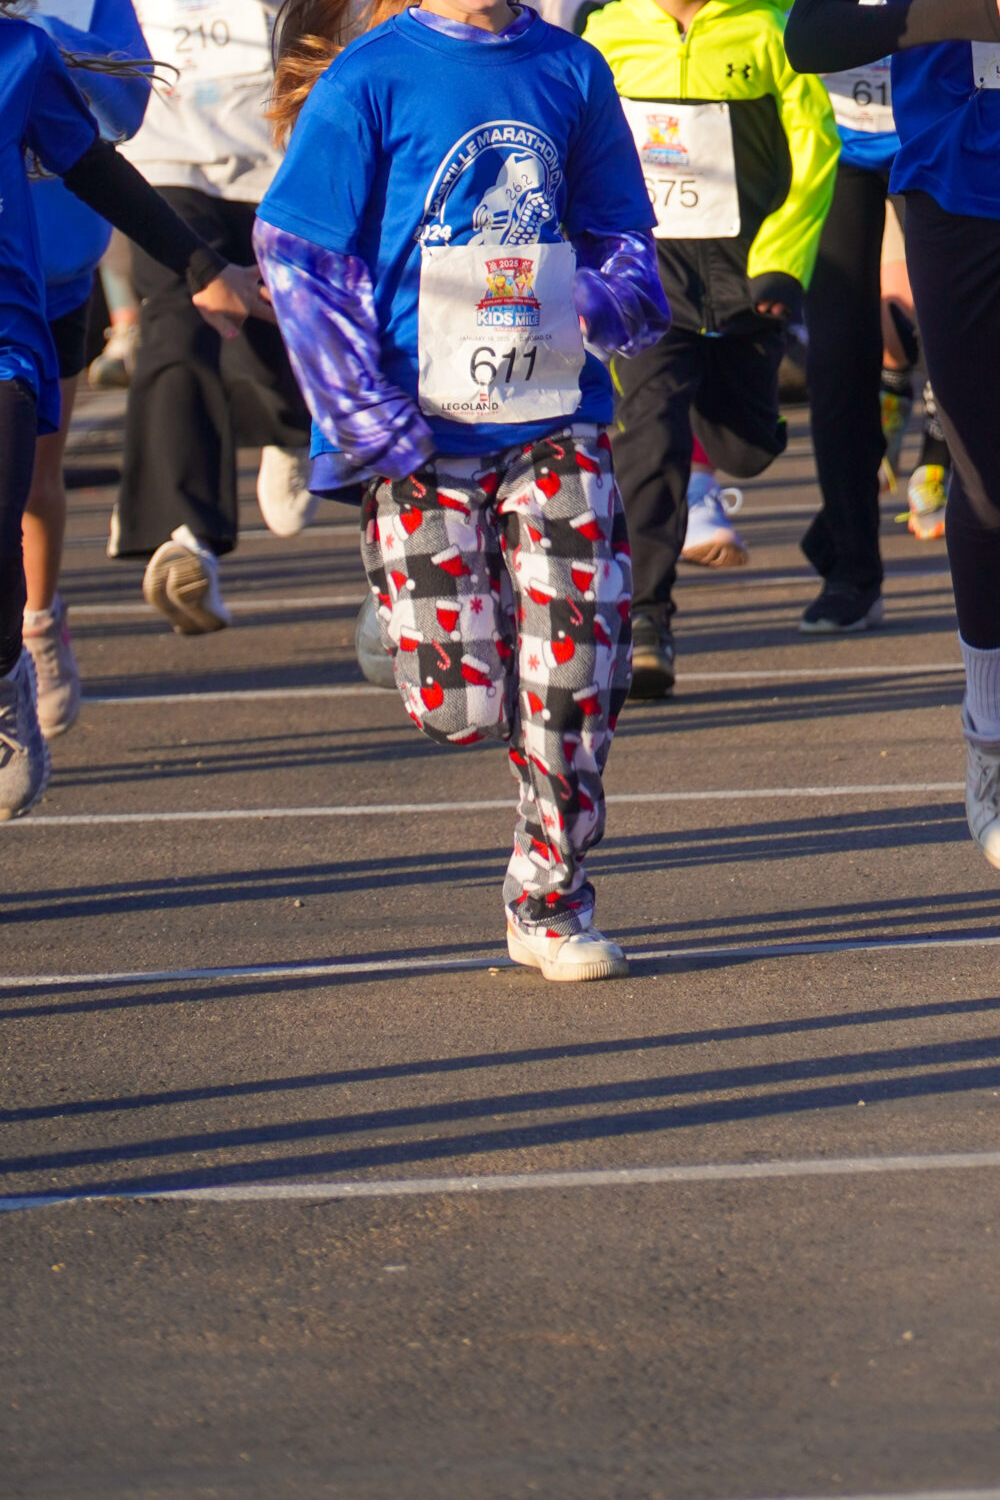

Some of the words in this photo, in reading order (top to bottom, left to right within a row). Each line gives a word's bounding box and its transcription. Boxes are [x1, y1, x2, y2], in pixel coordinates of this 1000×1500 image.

[174, 19, 230, 53] 210
[476, 127, 558, 171] MARATHON
[505, 174, 533, 201] 26.2
[499, 259, 518, 268] 2025
[477, 311, 514, 326] KIDS
[514, 314, 540, 326] MILE
[470, 346, 537, 387] 611
[441, 400, 499, 412] LEGOLAND
